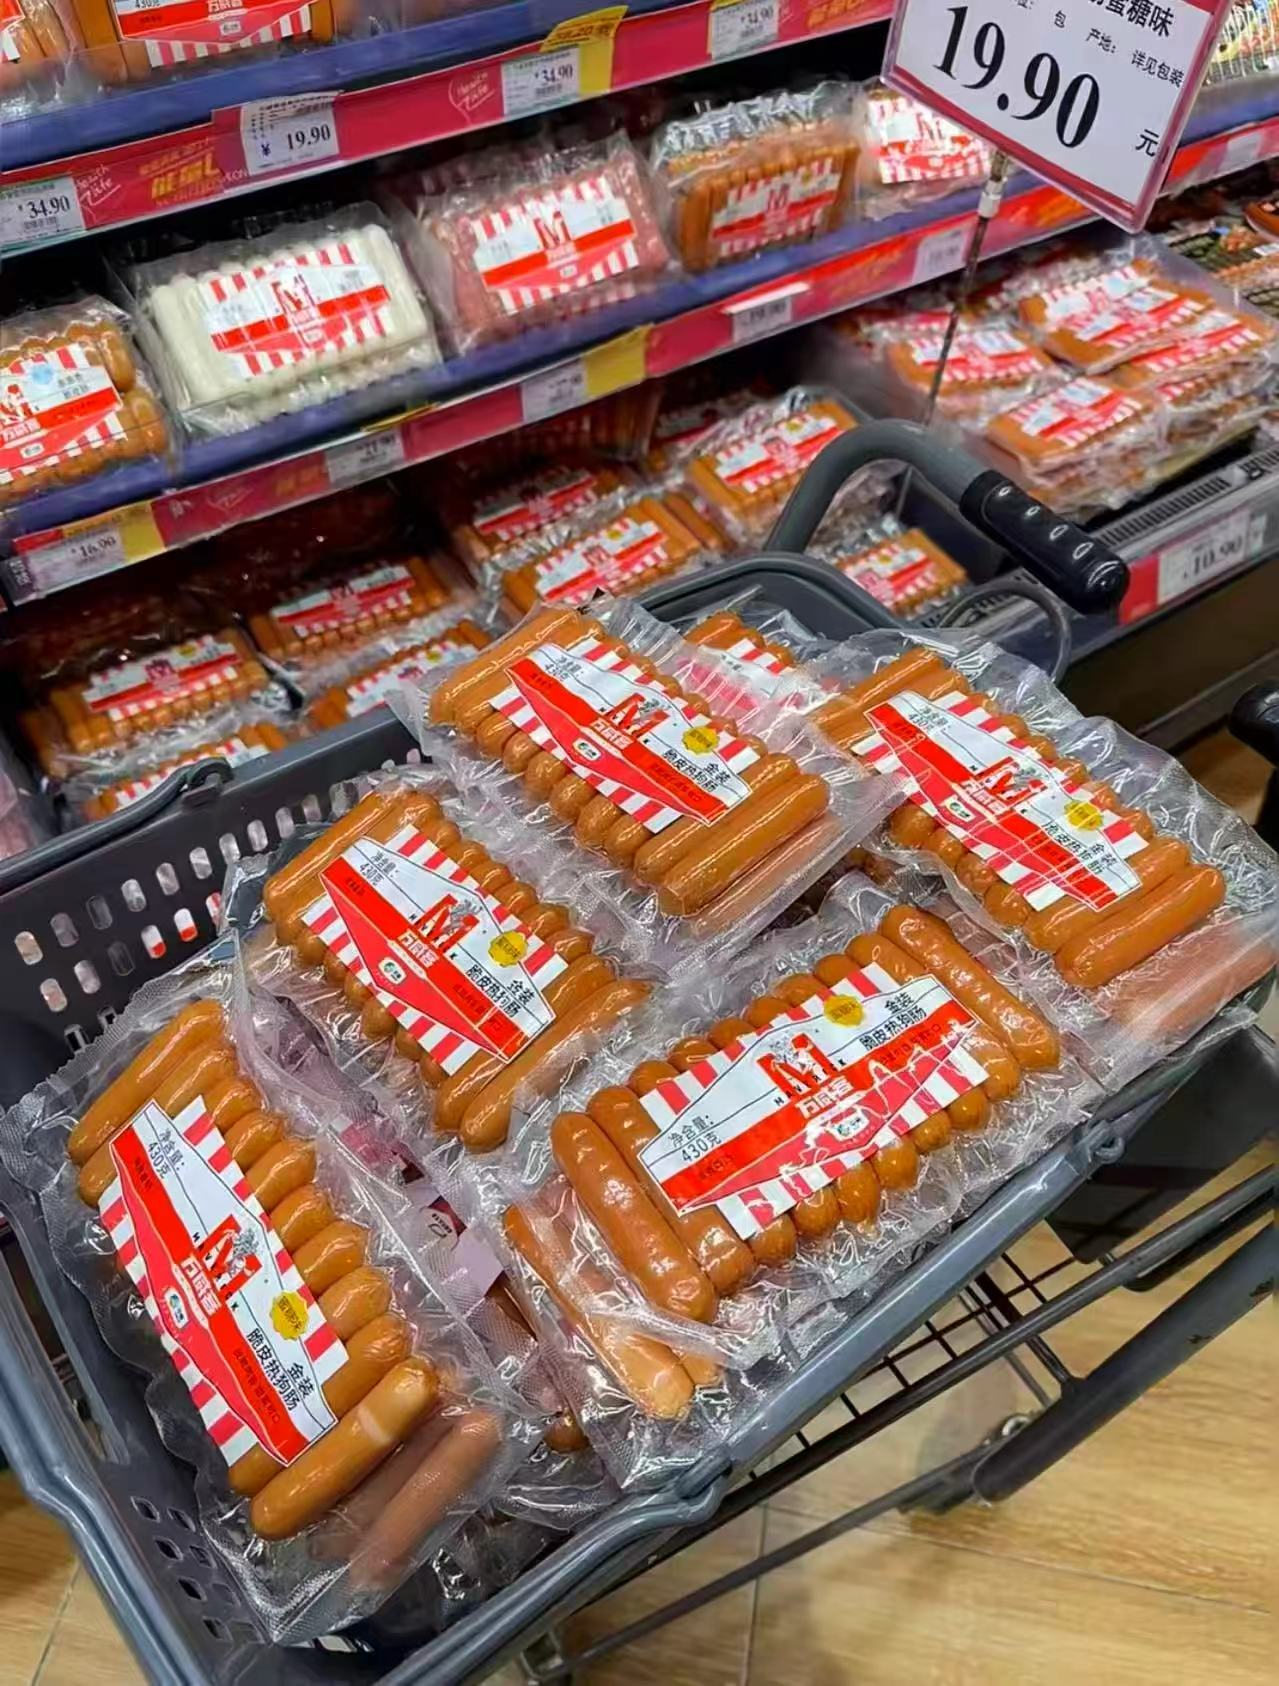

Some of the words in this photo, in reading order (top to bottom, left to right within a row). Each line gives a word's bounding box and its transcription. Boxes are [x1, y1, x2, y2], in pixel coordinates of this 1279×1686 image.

[1088, 0, 1174, 37] 蜜糖味
[1053, 10, 1066, 29] 包
[1086, 28, 1116, 53] 产地：
[1130, 50, 1184, 88] 详见包装
[541, 64, 573, 83] 34.90
[932, 6, 1100, 148] 19.90
[287, 123, 331, 150] 19.90
[1135, 129, 1160, 157] 元
[27, 195, 70, 219] 34.90
[884, 992, 914, 1014] 金装
[859, 1005, 927, 1051] 脆皮热狗肠
[668, 1114, 714, 1148] 净含量：
[682, 1131, 721, 1161] 430克
[148, 1141, 171, 1179] 430克
[247, 1328, 300, 1411] 脆皮热狗肠
[287, 1362, 315, 1398] 金装
